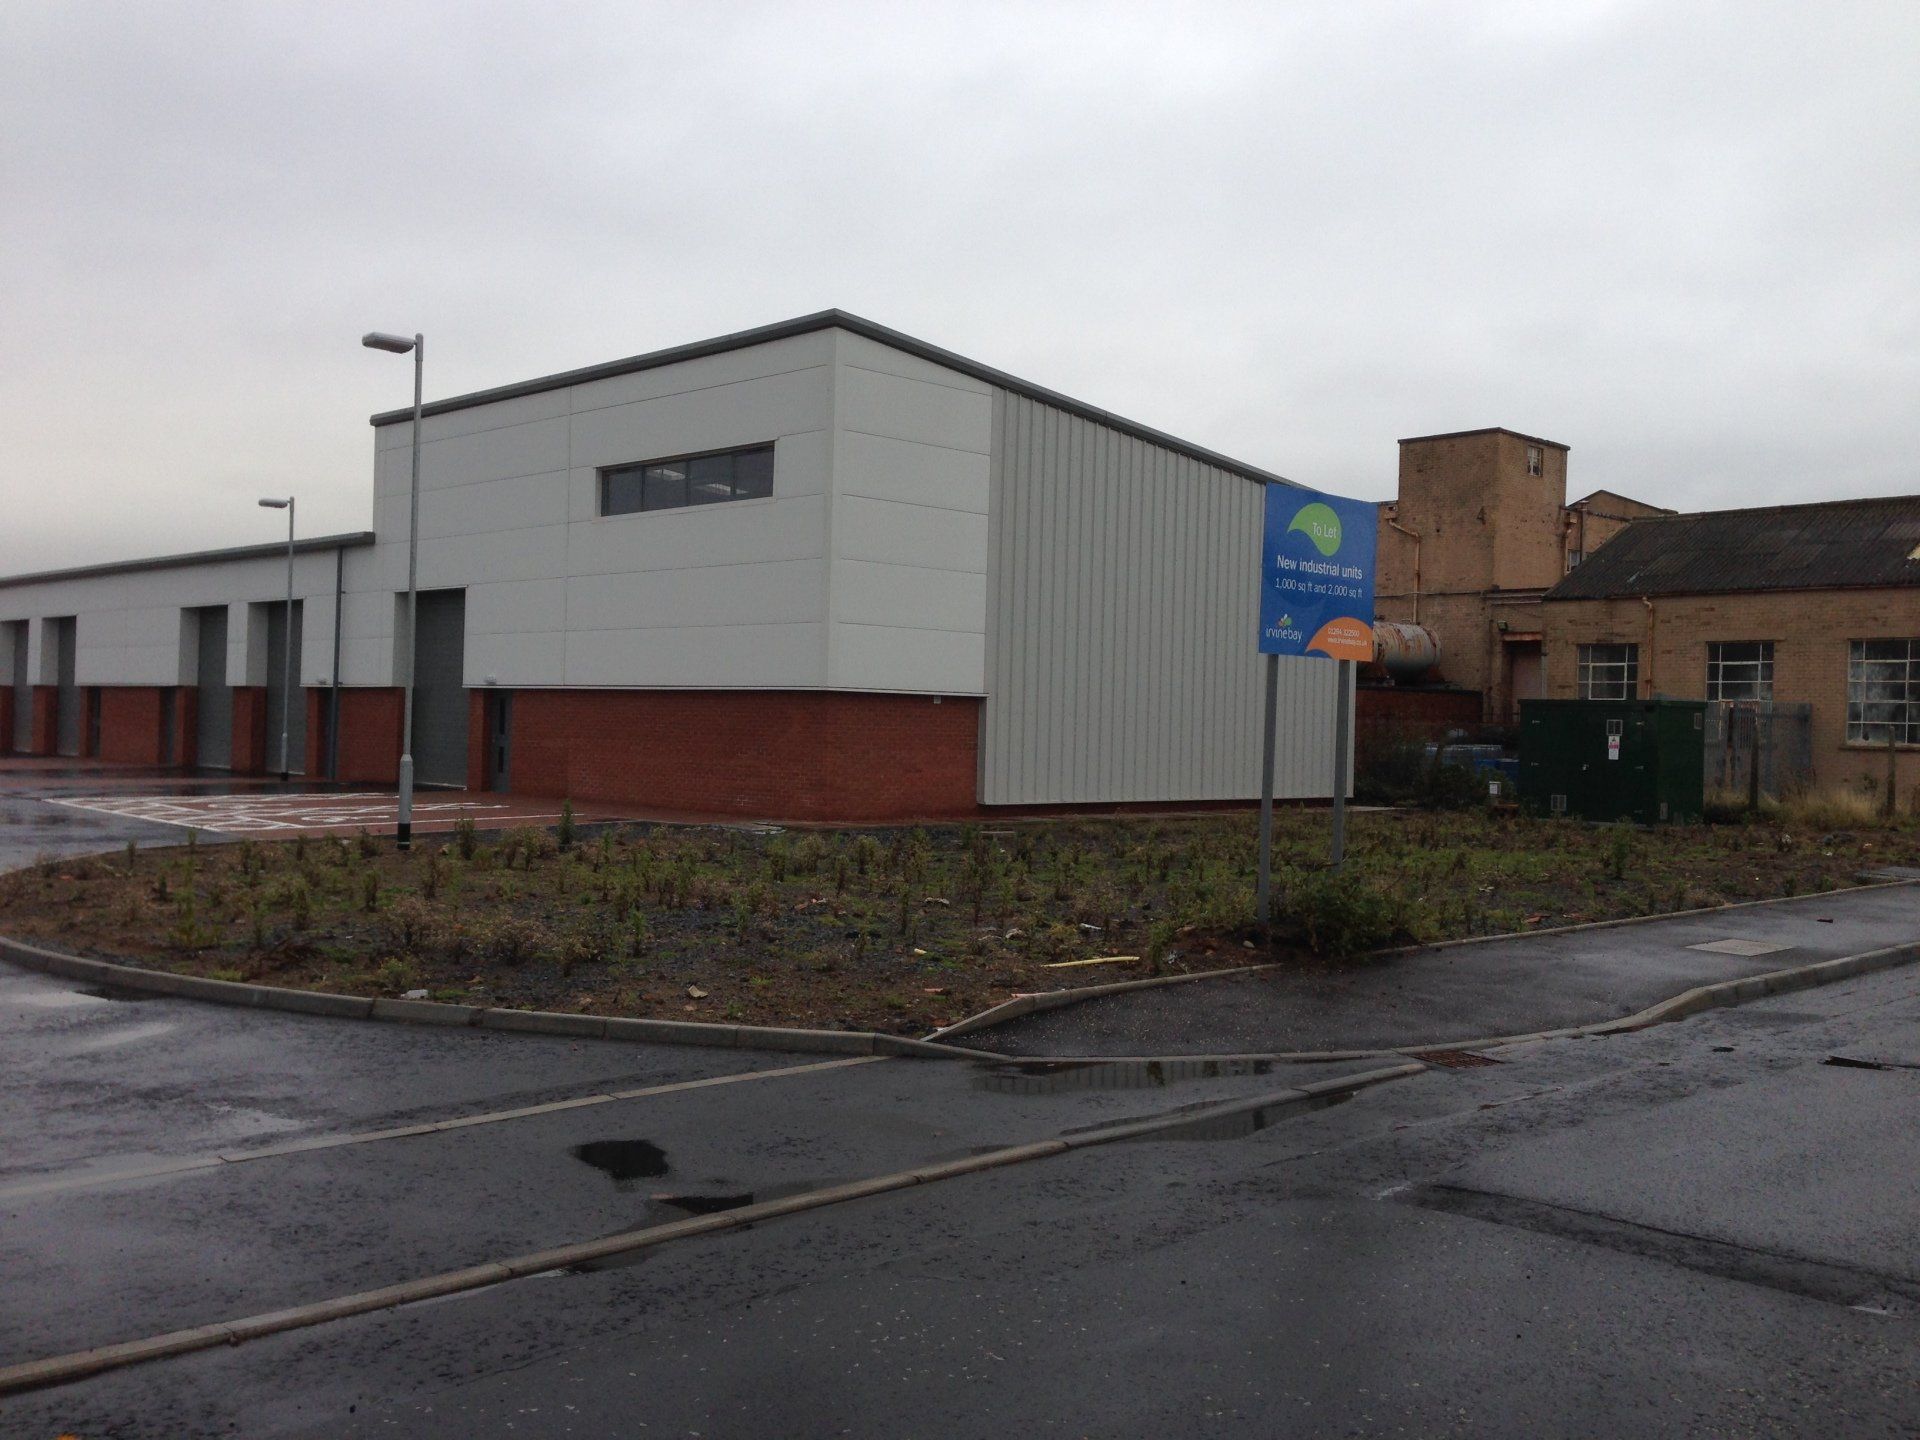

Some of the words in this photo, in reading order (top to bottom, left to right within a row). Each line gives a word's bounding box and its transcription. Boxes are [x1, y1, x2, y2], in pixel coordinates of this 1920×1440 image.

[1312, 522, 1322, 536] To
[1323, 524, 1337, 538] Let
[1277, 555, 1298, 570] New
[1299, 558, 1340, 576] industrial
[1341, 564, 1363, 580] units
[1298, 582, 1305, 593] sq
[1307, 581, 1313, 592] ft
[1313, 583, 1327, 595] and
[1328, 584, 1348, 598] 2,000
[1349, 589, 1357, 599] sq
[1358, 587, 1363, 598] ft
[1266, 625, 1302, 643] irvinebay
